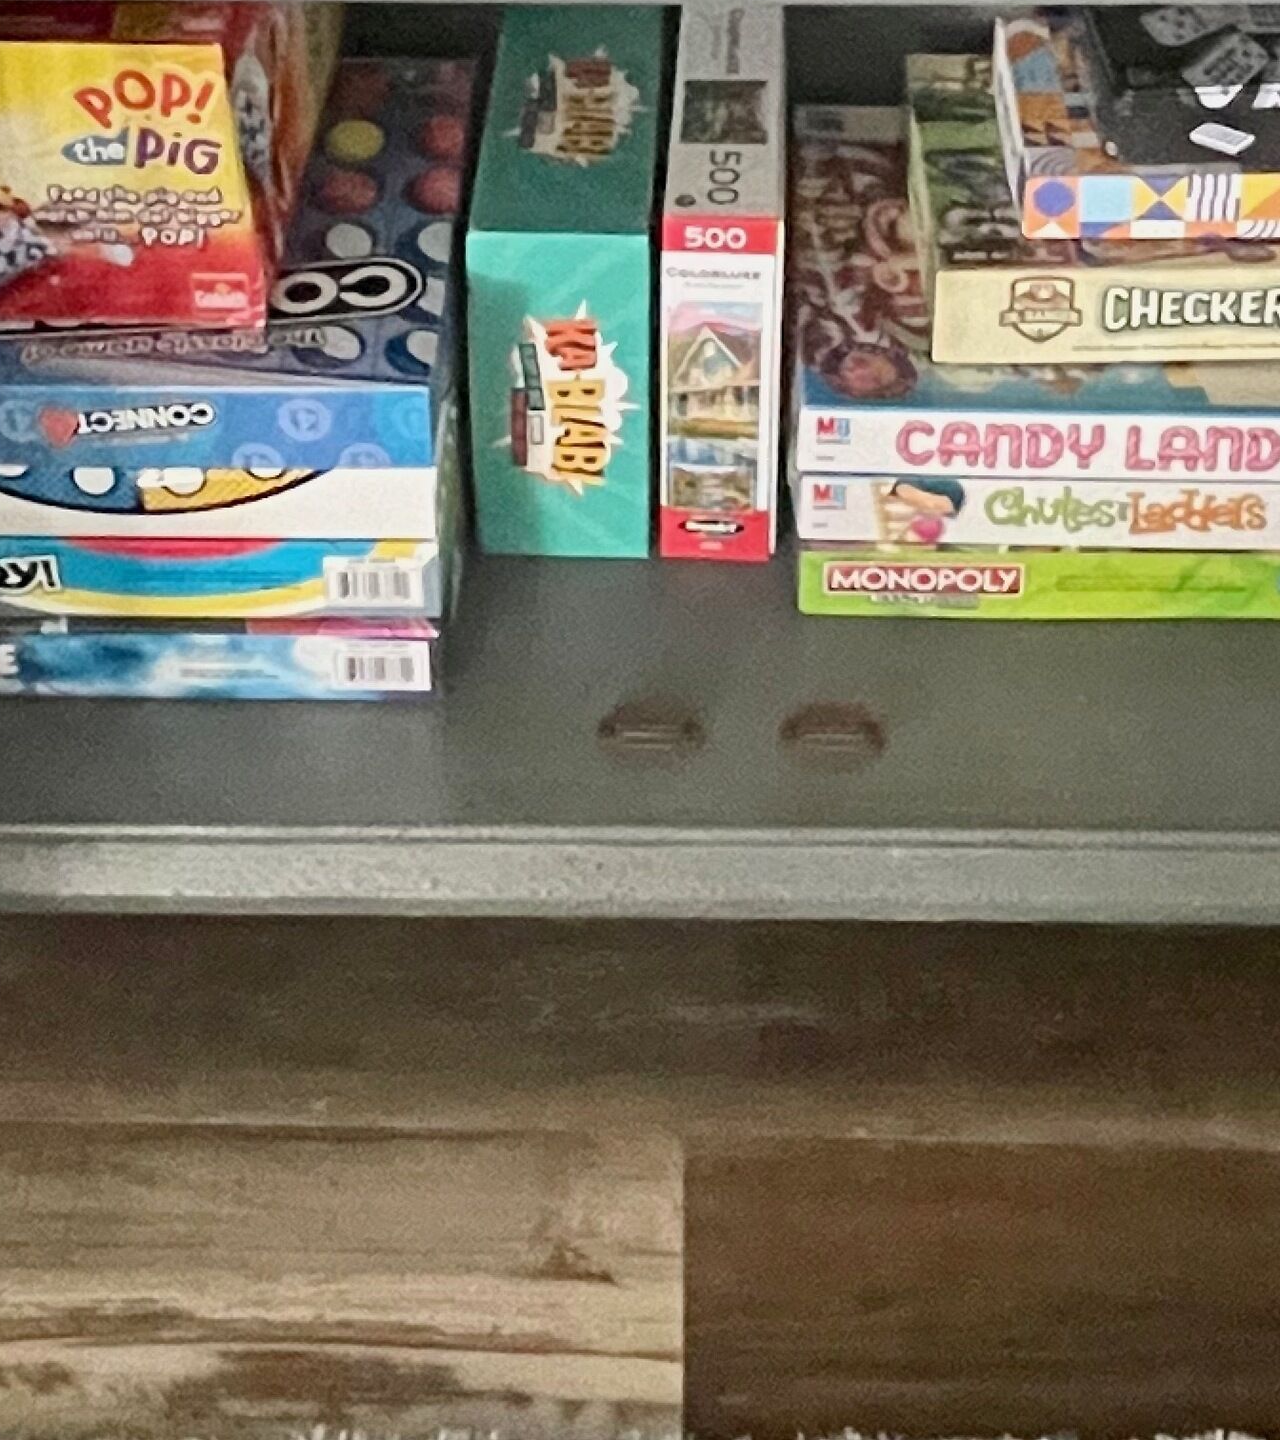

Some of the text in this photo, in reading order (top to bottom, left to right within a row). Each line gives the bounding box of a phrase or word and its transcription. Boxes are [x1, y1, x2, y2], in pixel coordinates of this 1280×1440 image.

[73, 69, 216, 130] POP!
[72, 138, 126, 162] the
[707, 150, 742, 205] 500
[684, 226, 747, 250] 500
[75, 403, 216, 435] CONNECT
[896, 419, 1106, 470] CANDY
[830, 567, 1018, 593] MONOPOLY
